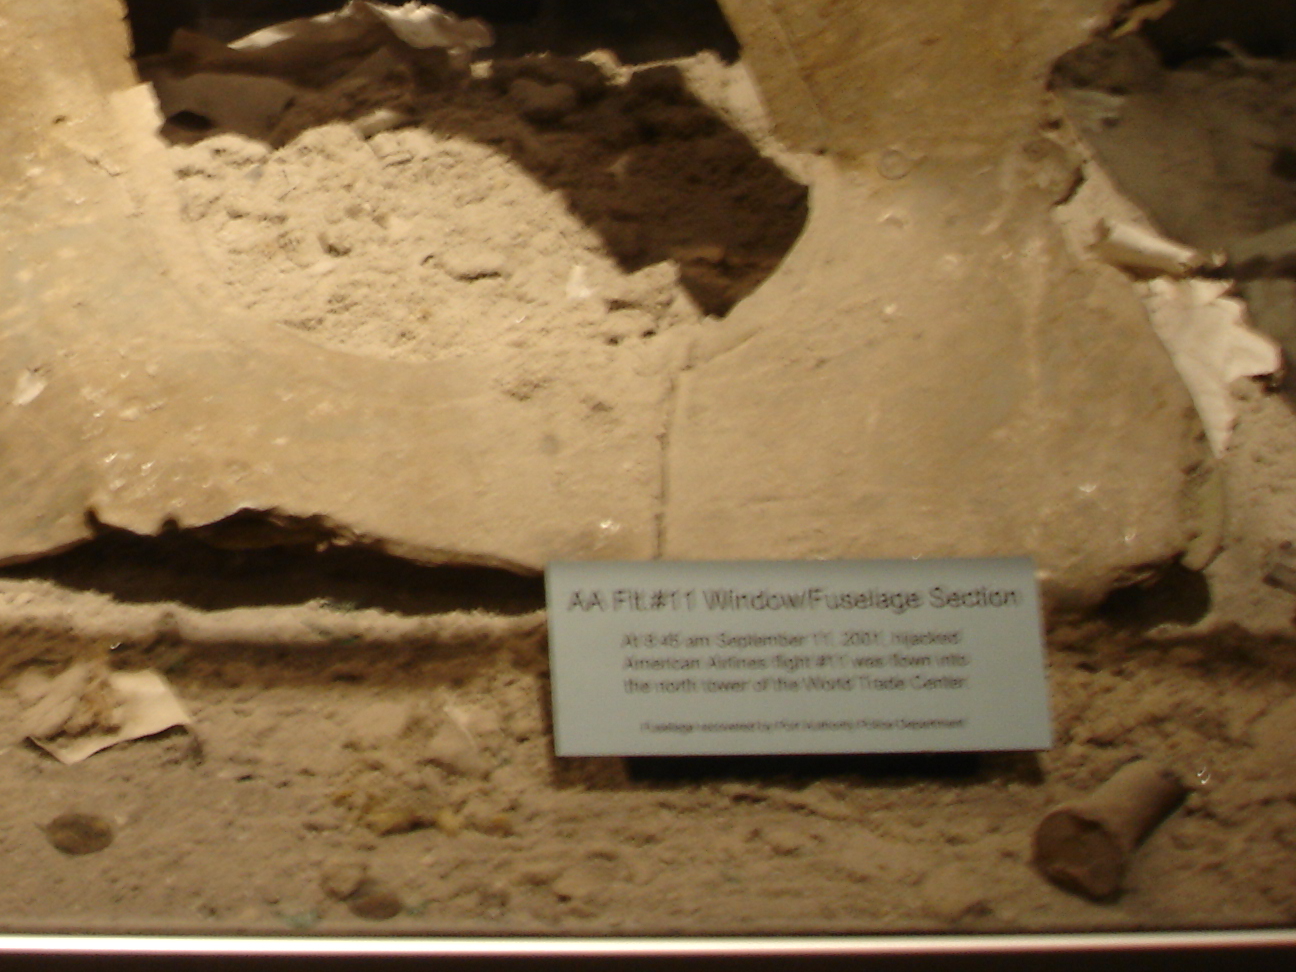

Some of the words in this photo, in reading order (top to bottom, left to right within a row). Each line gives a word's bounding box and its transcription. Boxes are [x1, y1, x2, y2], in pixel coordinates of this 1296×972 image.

[567, 588, 605, 612] AA
[702, 586, 923, 614] Window/Fuselage
[928, 584, 1019, 609] Section
[621, 632, 639, 649] At
[686, 635, 710, 648] am
[716, 631, 806, 651] September
[893, 630, 962, 648] hijacked
[622, 655, 701, 671] American
[708, 654, 768, 671] Airlines
[772, 653, 811, 673] flight
[815, 654, 848, 670] #11
[852, 656, 888, 669] was
[891, 652, 931, 668] flown
[938, 653, 972, 668] into
[623, 678, 651, 694] the
[655, 678, 697, 694] north
[701, 678, 750, 694] tower
[753, 676, 774, 693] of
[774, 676, 799, 692] the
[802, 676, 853, 693] World
[856, 675, 905, 692] Trade
